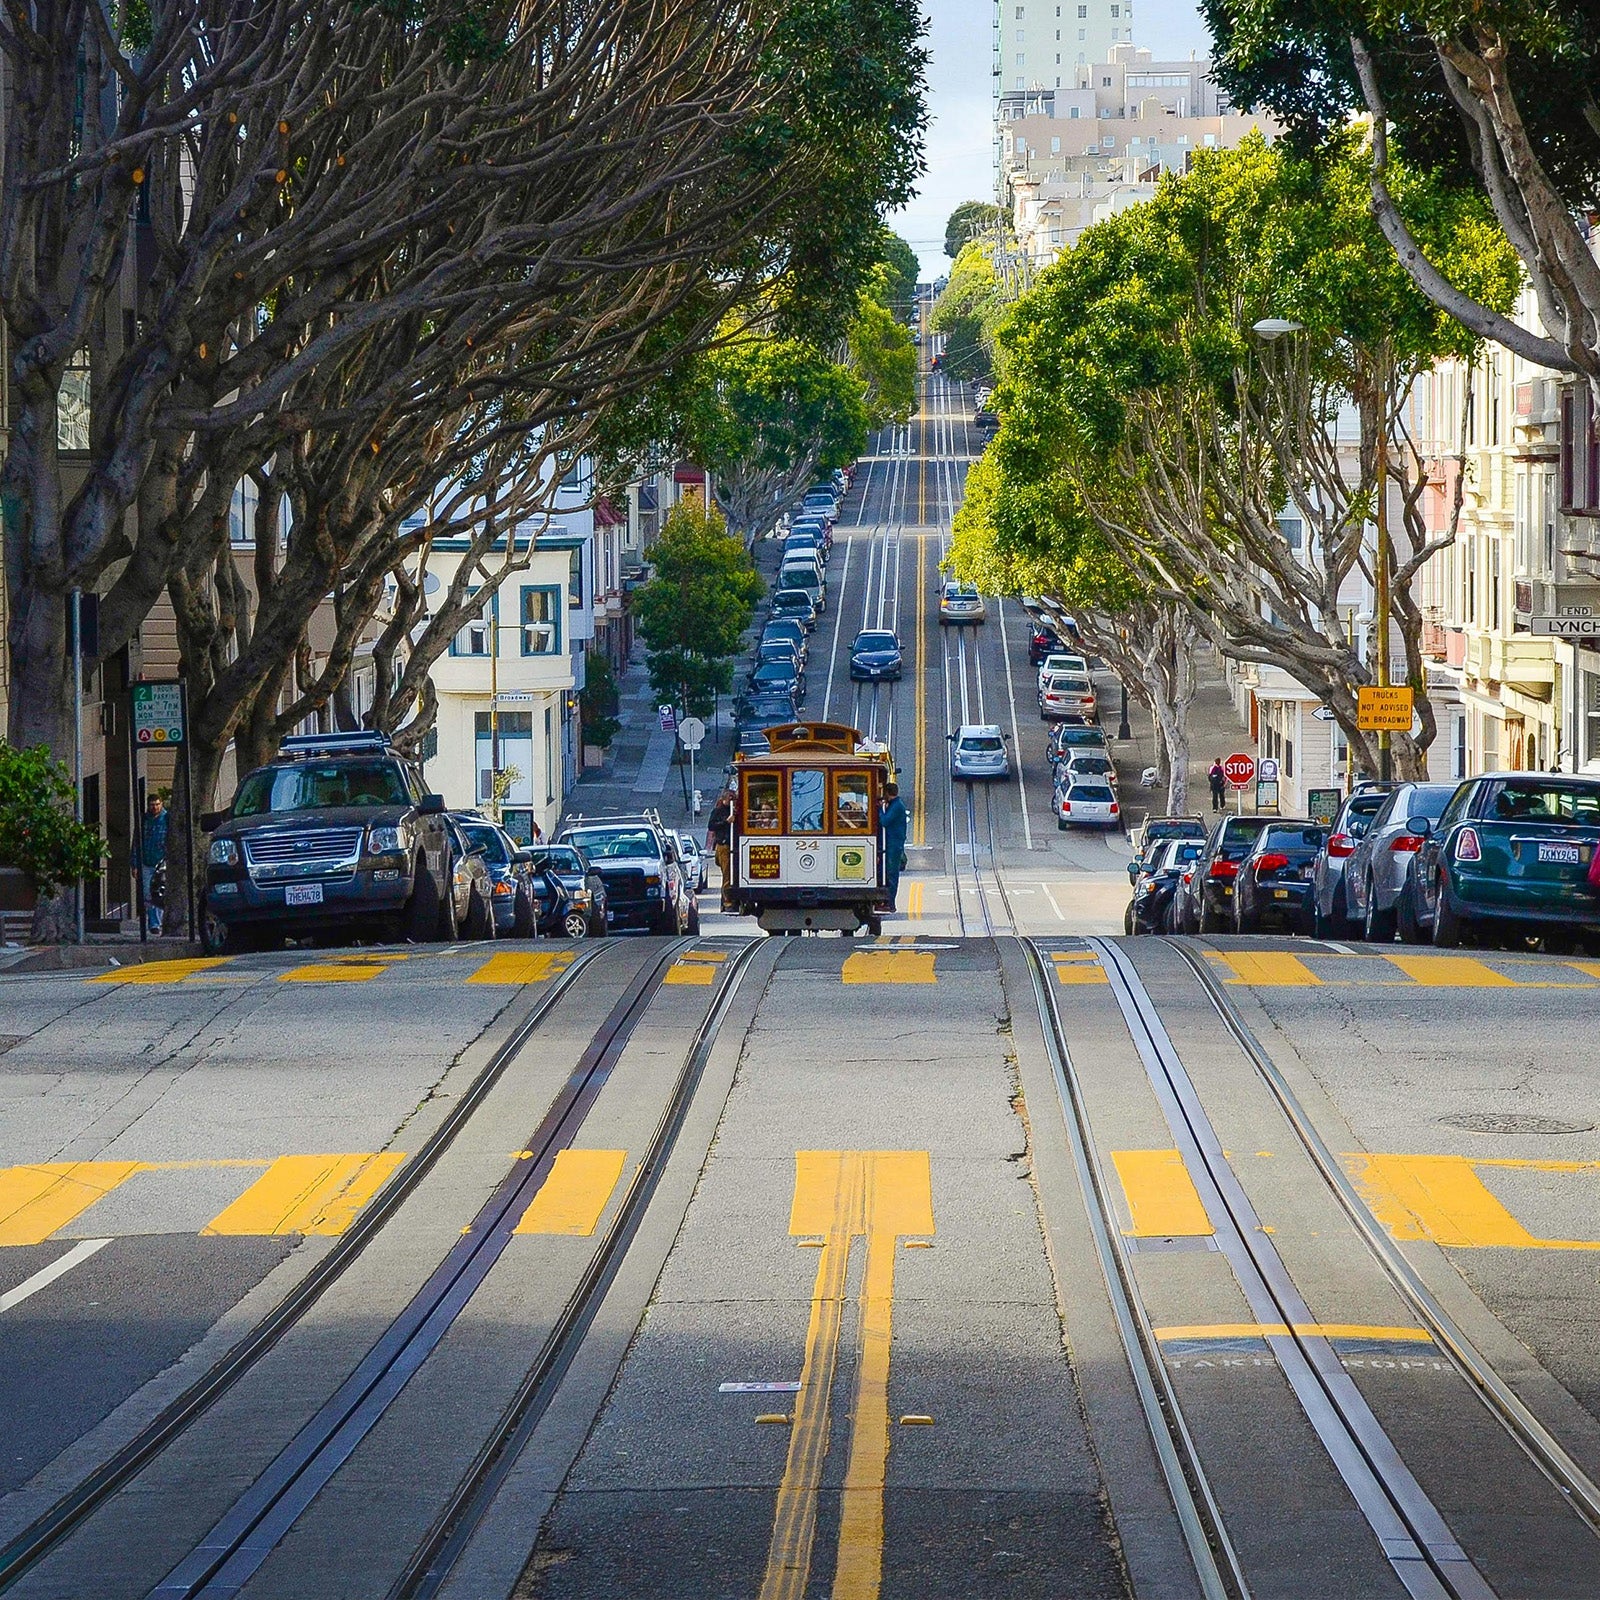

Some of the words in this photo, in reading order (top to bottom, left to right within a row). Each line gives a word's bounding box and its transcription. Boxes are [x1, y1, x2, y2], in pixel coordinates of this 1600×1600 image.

[1567, 606, 1589, 615] END
[1549, 621, 1600, 632] LYNCH
[139, 687, 146, 700] 2
[1372, 691, 1399, 699] TRUCKS
[1361, 703, 1375, 711] NOT
[1380, 703, 1409, 712] ADVISED
[1359, 715, 1370, 723] ON
[1373, 715, 1410, 724] BROADWAY
[140, 730, 148, 739] A
[156, 730, 163, 739] C
[171, 729, 178, 738] G
[1226, 762, 1253, 775] STOP
[795, 840, 820, 851] 24
[1540, 849, 1578, 861] 7KMY945
[287, 890, 321, 903] 7HEH478
[1171, 1358, 1277, 1368] TAKE
